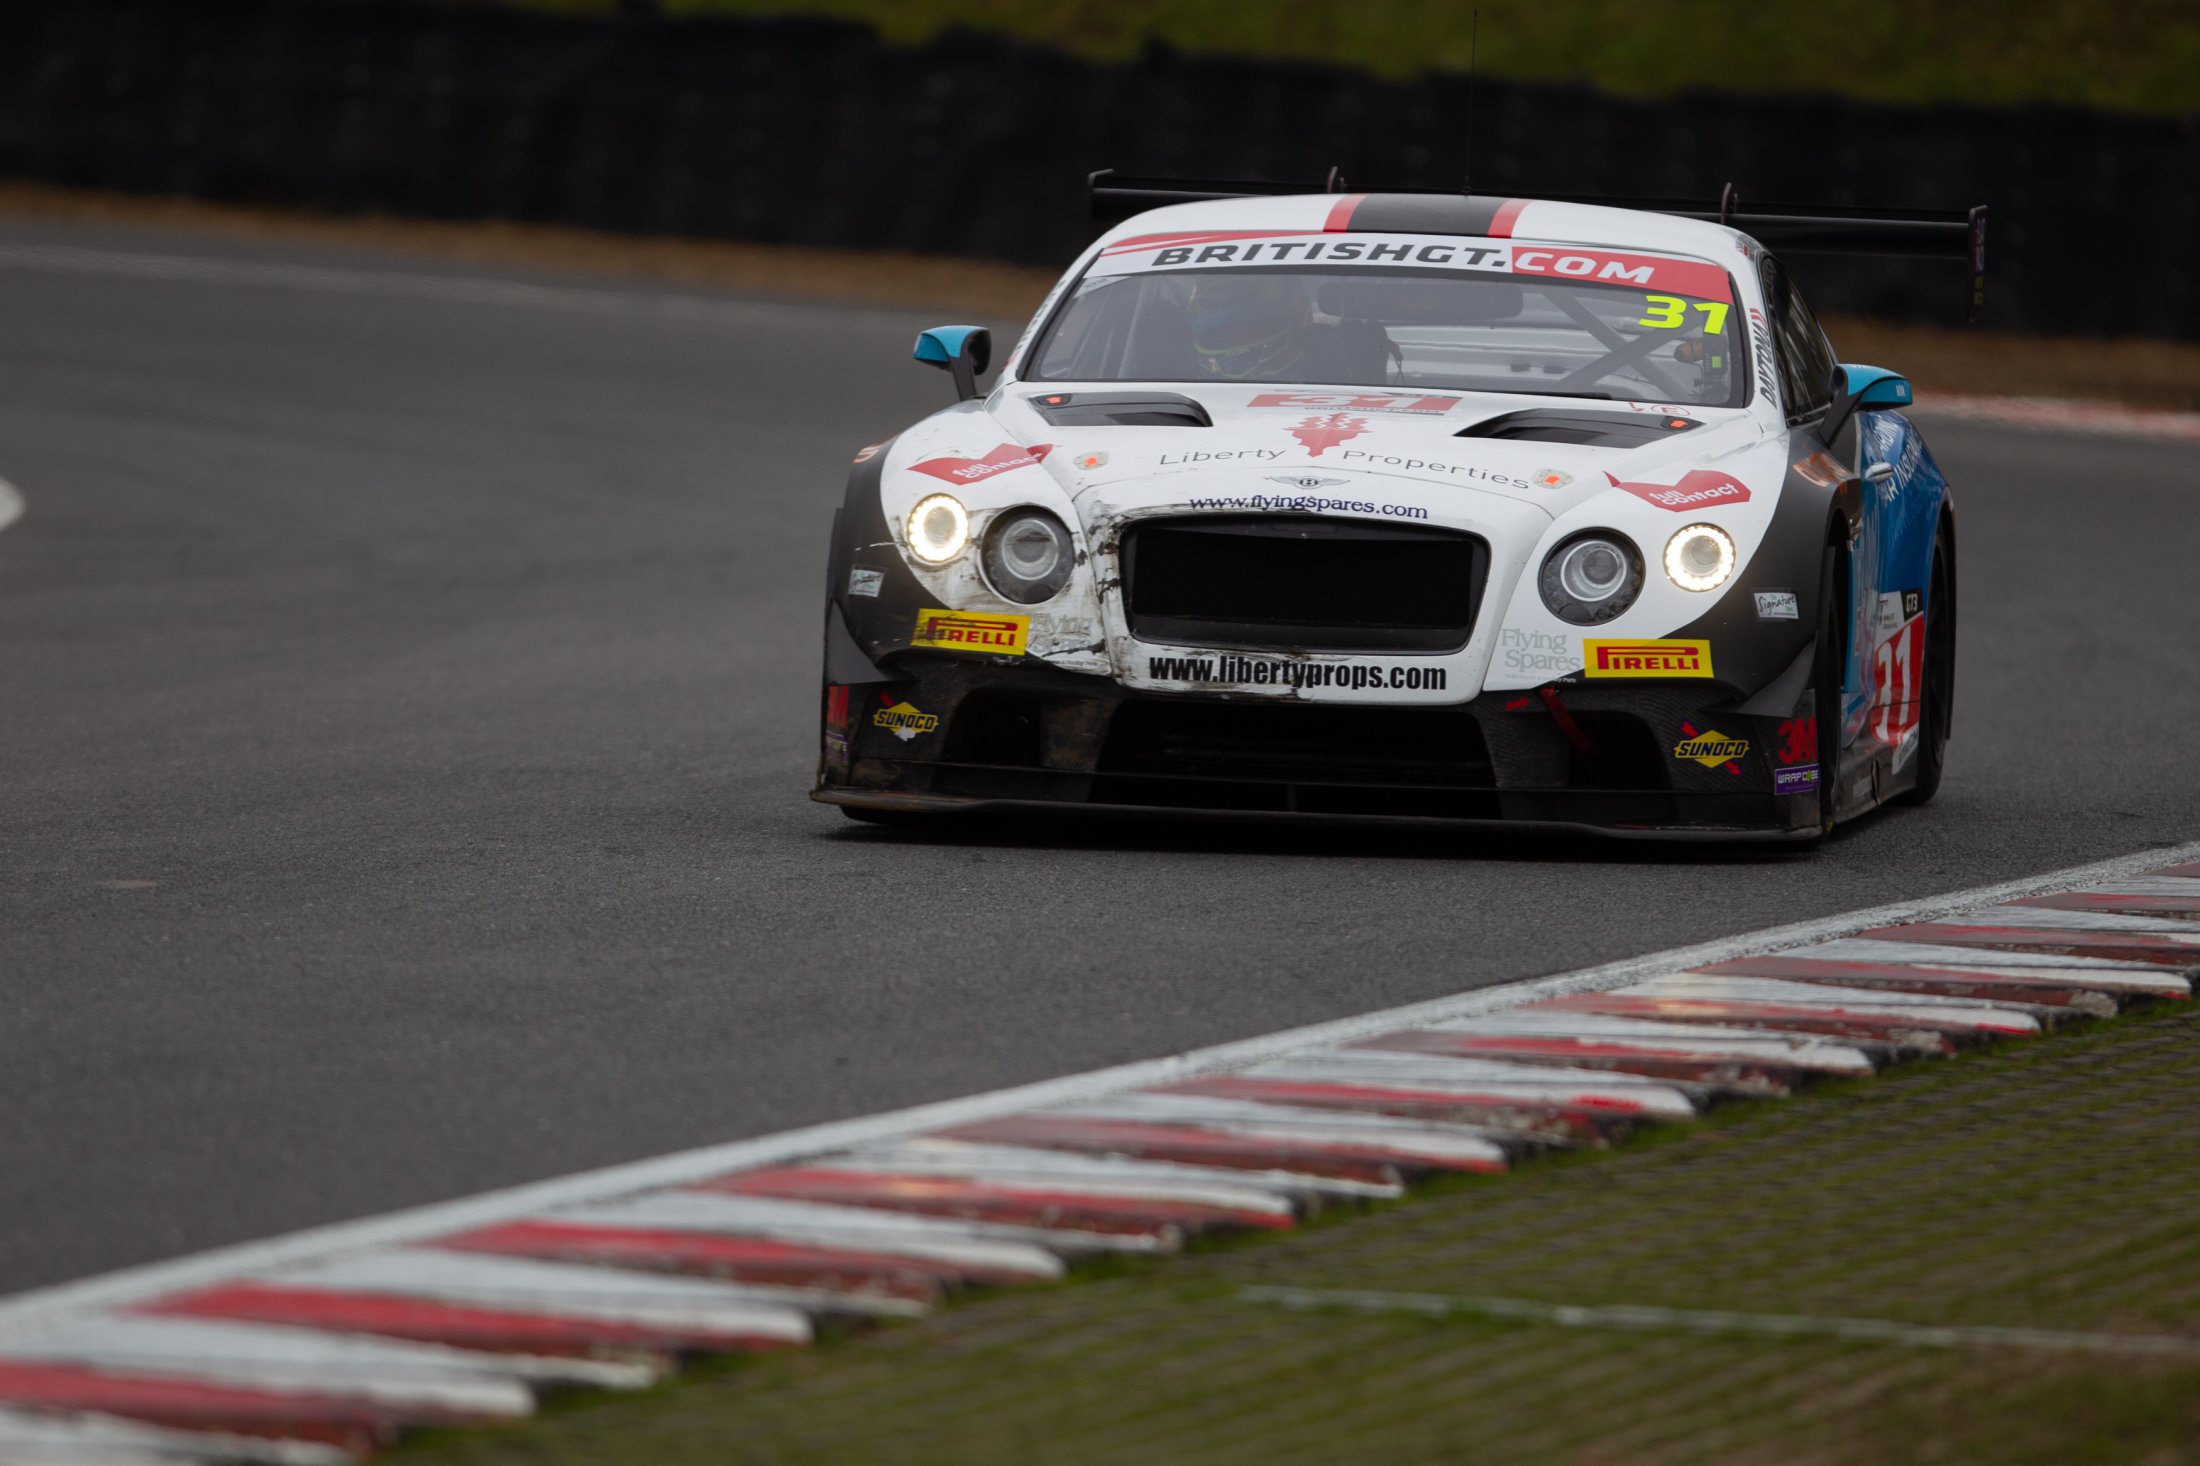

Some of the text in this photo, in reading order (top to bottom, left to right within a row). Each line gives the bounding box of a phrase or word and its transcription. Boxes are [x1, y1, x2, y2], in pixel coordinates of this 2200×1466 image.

[1151, 242, 1655, 284] BRITISHGT.COM
[1638, 295, 1729, 335] 31
[1750, 321, 1778, 410] DAYTONA
[1278, 394, 1425, 409] 31
[953, 463, 986, 477] full
[1159, 449, 1529, 489] Liberty Properties
[1648, 489, 1684, 500] full
[1662, 483, 1740, 505] contact
[1190, 494, 1429, 519] www.flyingspares.com
[1906, 593, 1918, 613] GT3
[926, 616, 1018, 647] PIRELLI
[1501, 628, 1567, 655] Flying
[1504, 649, 1580, 672] Spares
[1596, 646, 1699, 670] PIRELLI
[1149, 655, 1447, 690] www.libertyprops.com
[876, 710, 937, 730] SUNOCO
[1677, 741, 1746, 757] SUNOCO
[1777, 717, 1817, 764] 3M
